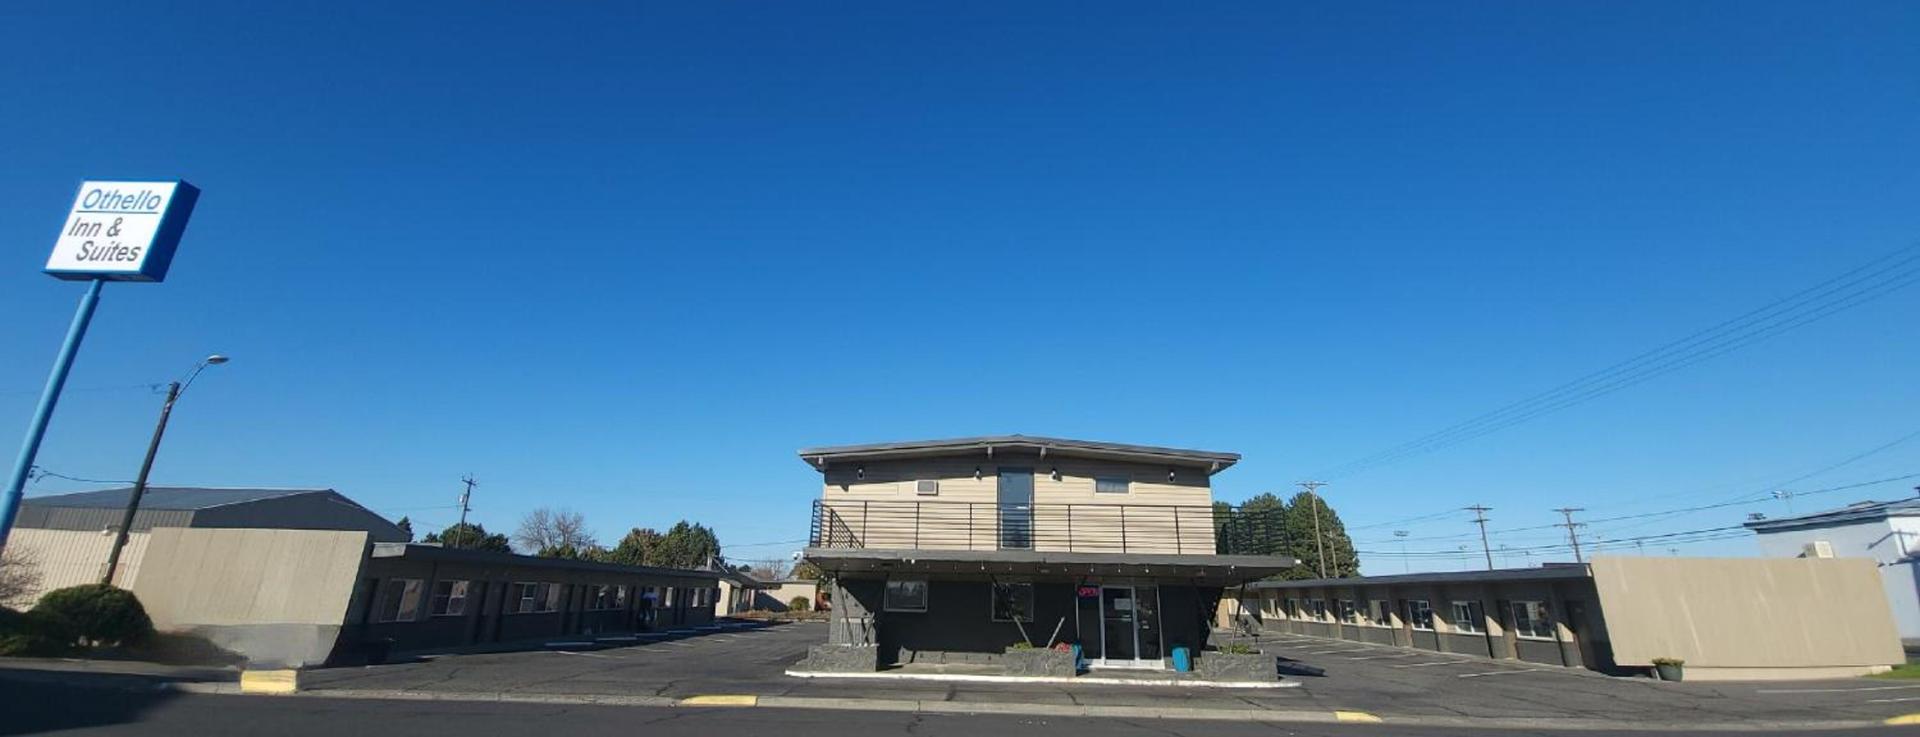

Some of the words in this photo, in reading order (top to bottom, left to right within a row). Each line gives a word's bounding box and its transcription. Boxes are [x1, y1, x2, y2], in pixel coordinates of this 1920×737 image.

[82, 188, 162, 210] Othello
[68, 217, 102, 237] Inn
[106, 217, 124, 237] &
[76, 241, 141, 262] Suites
